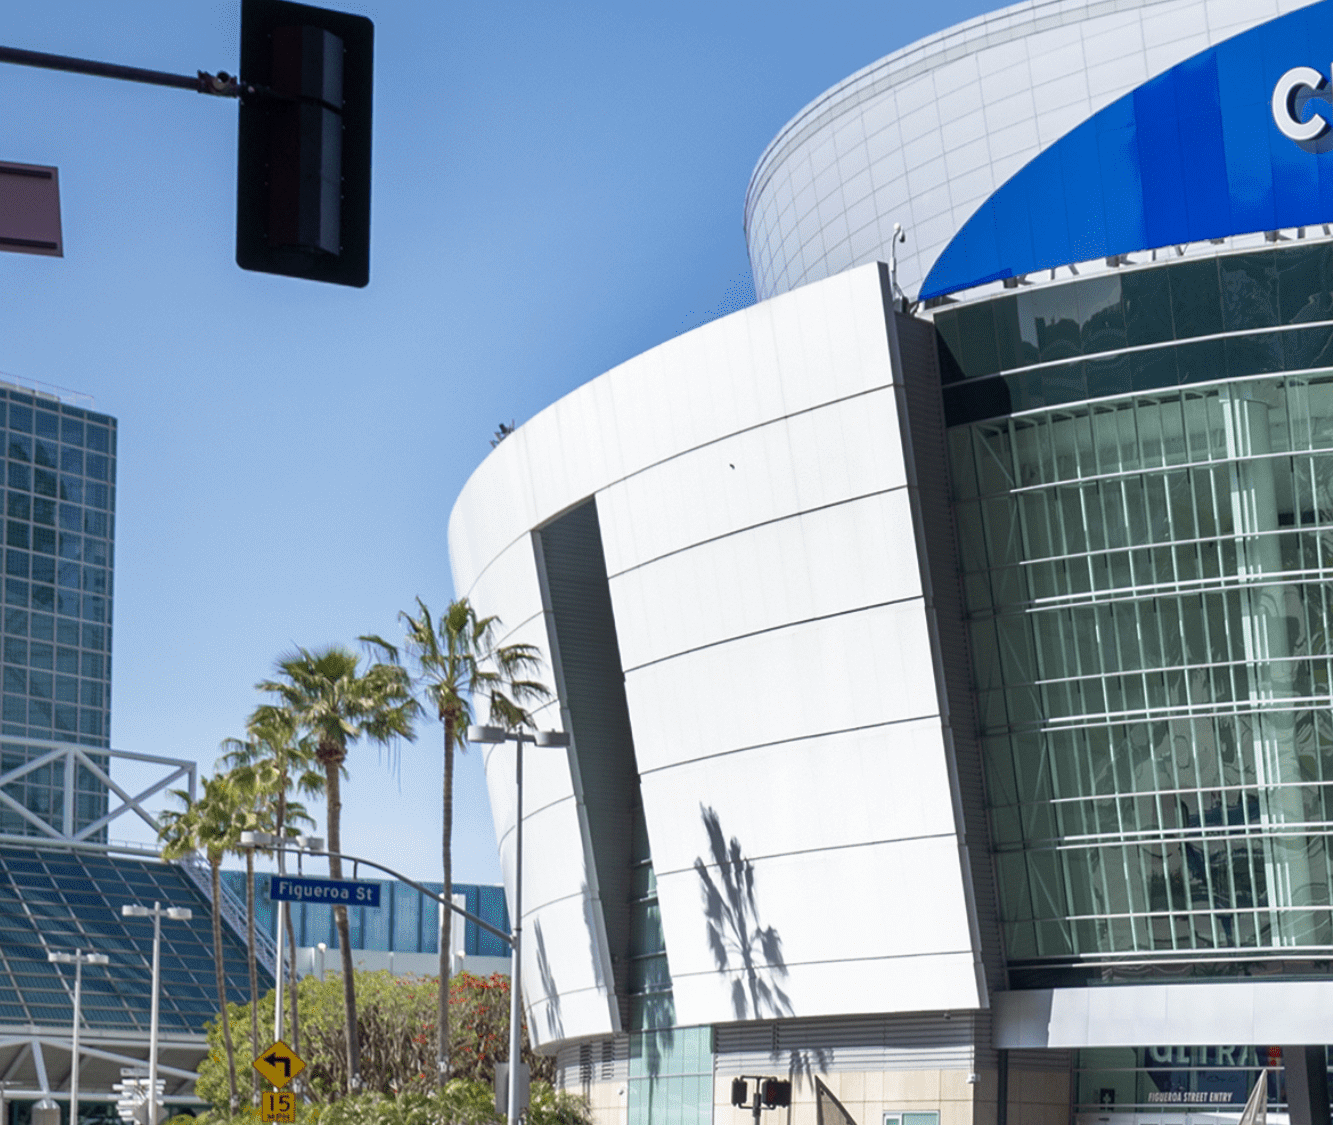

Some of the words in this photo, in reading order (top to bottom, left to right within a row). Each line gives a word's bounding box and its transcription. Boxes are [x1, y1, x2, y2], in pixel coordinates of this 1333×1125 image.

[279, 881, 349, 899] Figueroa
[356, 887, 372, 900] St
[270, 1094, 291, 1112] 15
[1148, 1092, 1181, 1102] FIGUEROA
[1183, 1092, 1208, 1102] STREET
[1209, 1092, 1233, 1102] ENTRY
